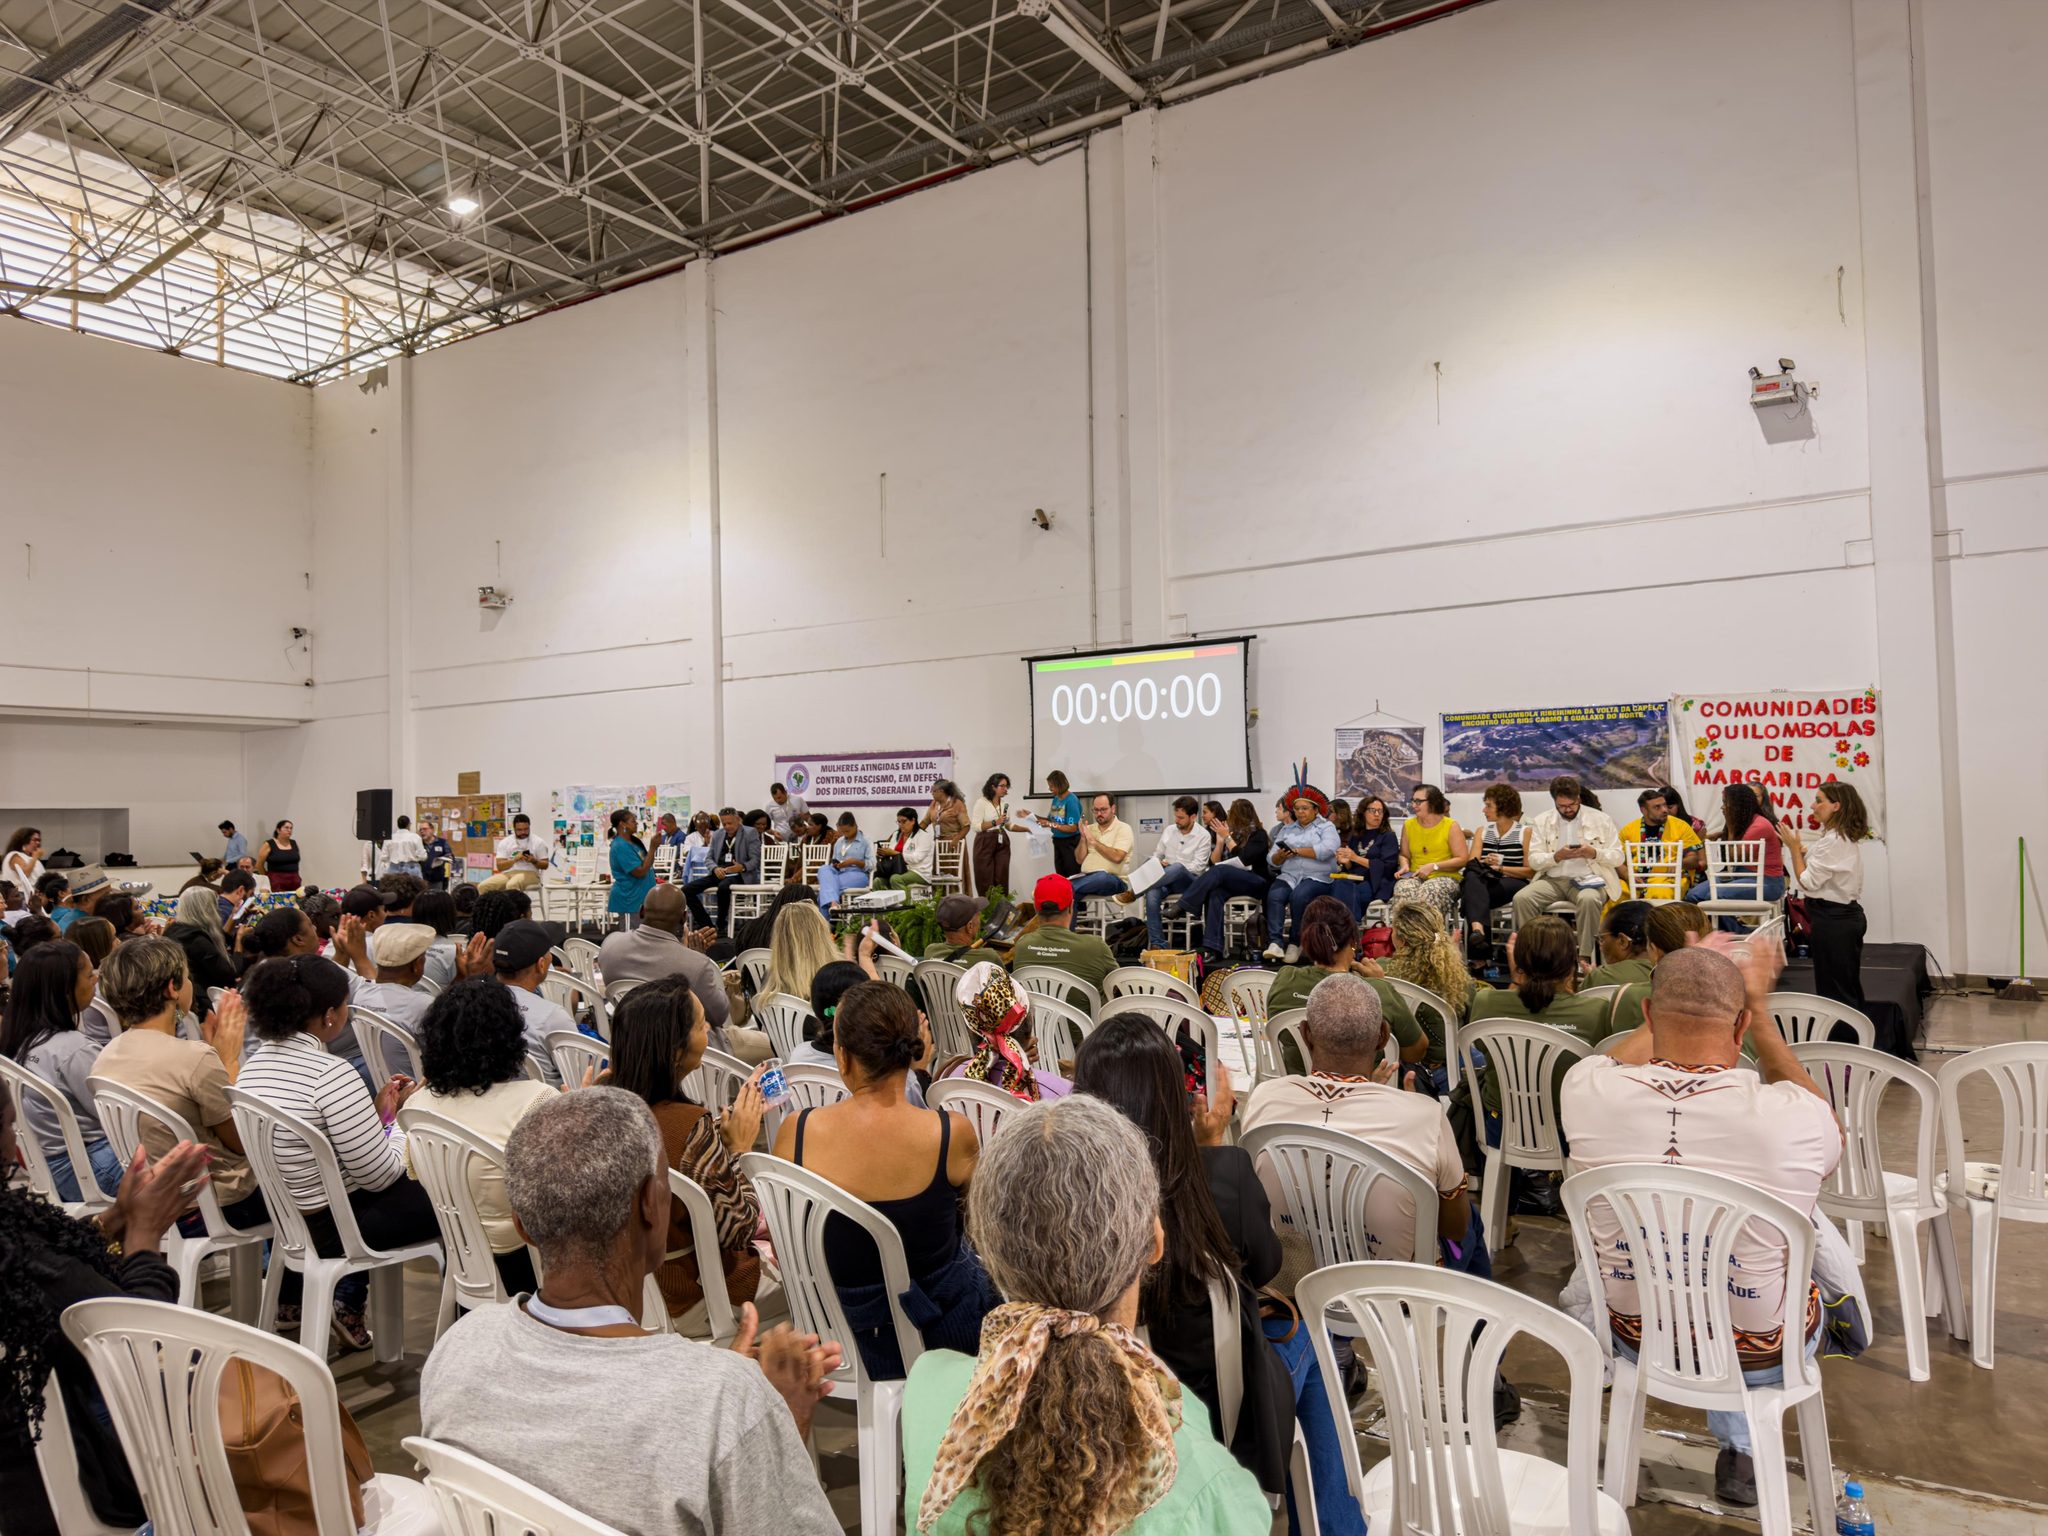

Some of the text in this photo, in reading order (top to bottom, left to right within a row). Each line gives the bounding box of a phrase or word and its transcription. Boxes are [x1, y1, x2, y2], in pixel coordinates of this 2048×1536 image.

[1052, 672, 1222, 726] 00:00:00
[1700, 696, 1876, 718] COMUNIDADES
[1445, 713, 1490, 721] COMUNIDADE
[1492, 711, 1538, 719] QUILOMBOLA
[1540, 708, 1582, 717] RIBEIRINHA
[1596, 706, 1618, 714] VOLTA
[1621, 705, 1631, 713] DA
[1619, 711, 1646, 719] NORTE.
[1705, 719, 1876, 742] QUILOMBOLAS
[1764, 745, 1794, 762] DE
[820, 761, 937, 773] MULHERES ATINGIDAS EM LUTA:
[815, 773, 943, 785] CONTRA O FASCISMO, EM DEFESA
[1693, 769, 1839, 789] MARGARIDA
[815, 787, 831, 796] DOS
[832, 786, 869, 796] DIREITOS,
[871, 785, 916, 795] SOBERANIA
[917, 785, 922, 794] E
